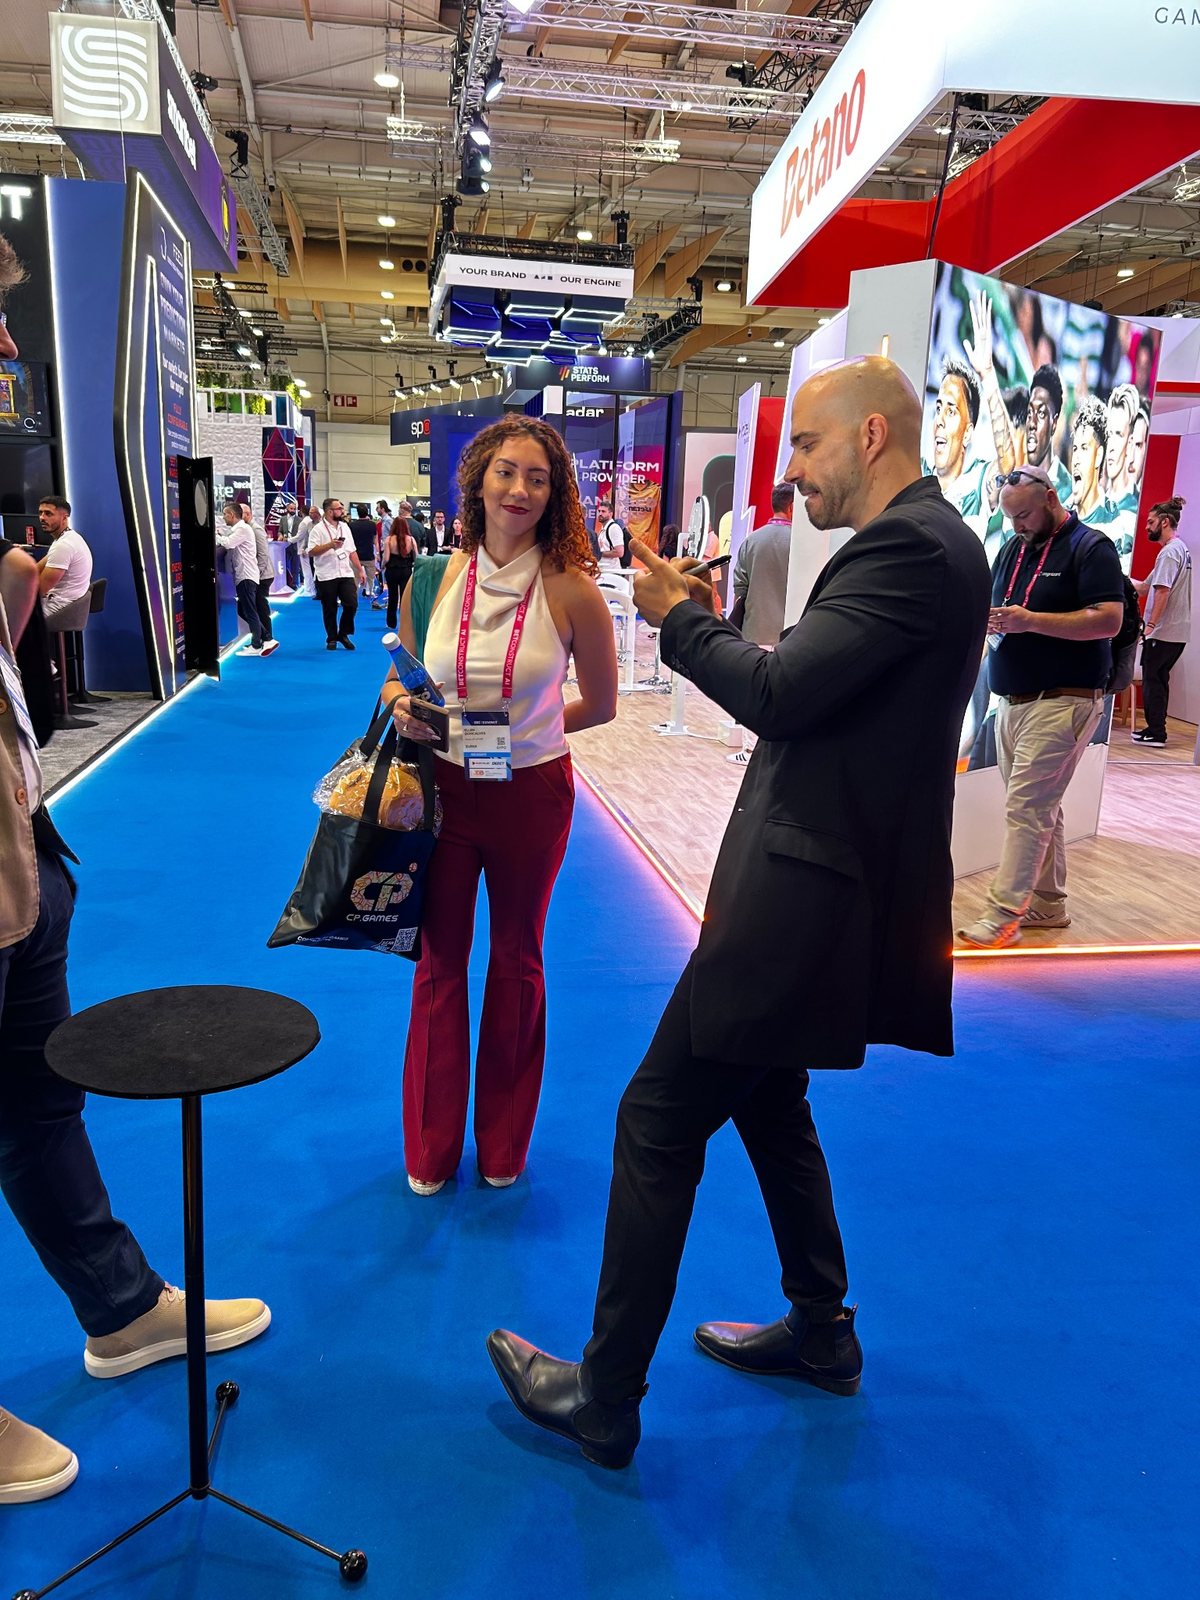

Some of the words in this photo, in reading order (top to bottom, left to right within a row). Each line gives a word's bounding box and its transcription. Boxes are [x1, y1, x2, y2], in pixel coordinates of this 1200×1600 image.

[780, 68, 866, 239] Betano
[459, 267, 488, 276] YOUR
[490, 269, 527, 279] BRAND
[560, 276, 582, 285] OUR
[583, 278, 622, 288] ENGINE
[572, 366, 599, 375] STATS
[570, 374, 610, 383] PERFORM
[566, 406, 604, 418] adar
[571, 459, 660, 472] PLATFORM
[582, 472, 646, 484] PROVIDER
[462, 576, 475, 622] BETCONSTRUCT
[505, 629, 520, 678] BETCONSTRUCT
[458, 637, 467, 686] BETCONSTRUCT
[346, 914, 399, 922] CP.GAMES
